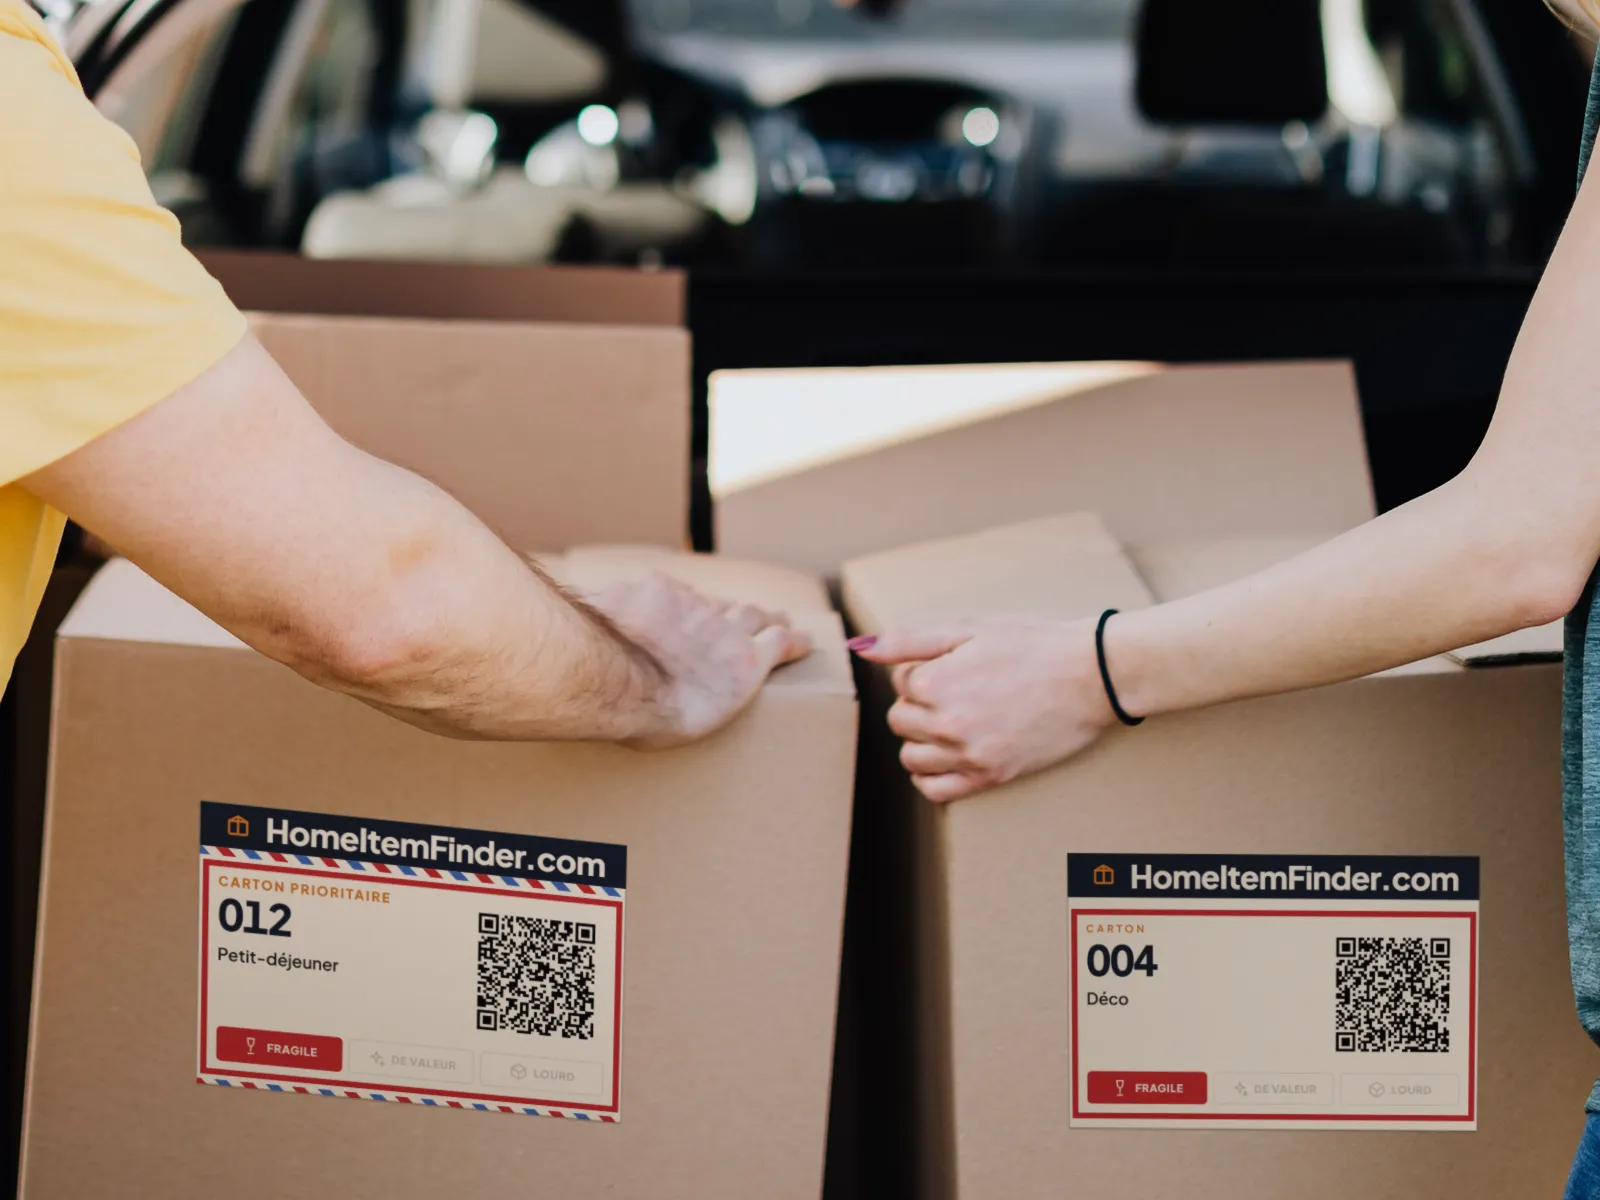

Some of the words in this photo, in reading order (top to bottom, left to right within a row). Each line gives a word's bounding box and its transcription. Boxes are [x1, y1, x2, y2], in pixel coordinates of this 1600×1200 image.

[266, 817, 606, 878] HomeItemFinder.com
[1131, 864, 1460, 892] HomeItemFinder.com
[218, 875, 285, 893] CARTON
[290, 883, 391, 904] PRIORITAIRE
[218, 897, 292, 937] 012
[1086, 924, 1145, 934] CARTON
[217, 947, 339, 973] Petit-déjeuner
[1087, 944, 1158, 977] 004
[1087, 992, 1129, 1006] Déco
[266, 1043, 318, 1058] FRAGILE
[391, 1054, 408, 1066] DE
[409, 1056, 456, 1071] VALEUR
[533, 1069, 575, 1083] LOURD
[1135, 1083, 1184, 1094] FRAGILE
[1254, 1084, 1271, 1094] DE
[1272, 1084, 1317, 1095] VALEUR
[1391, 1084, 1432, 1095] LOURD
